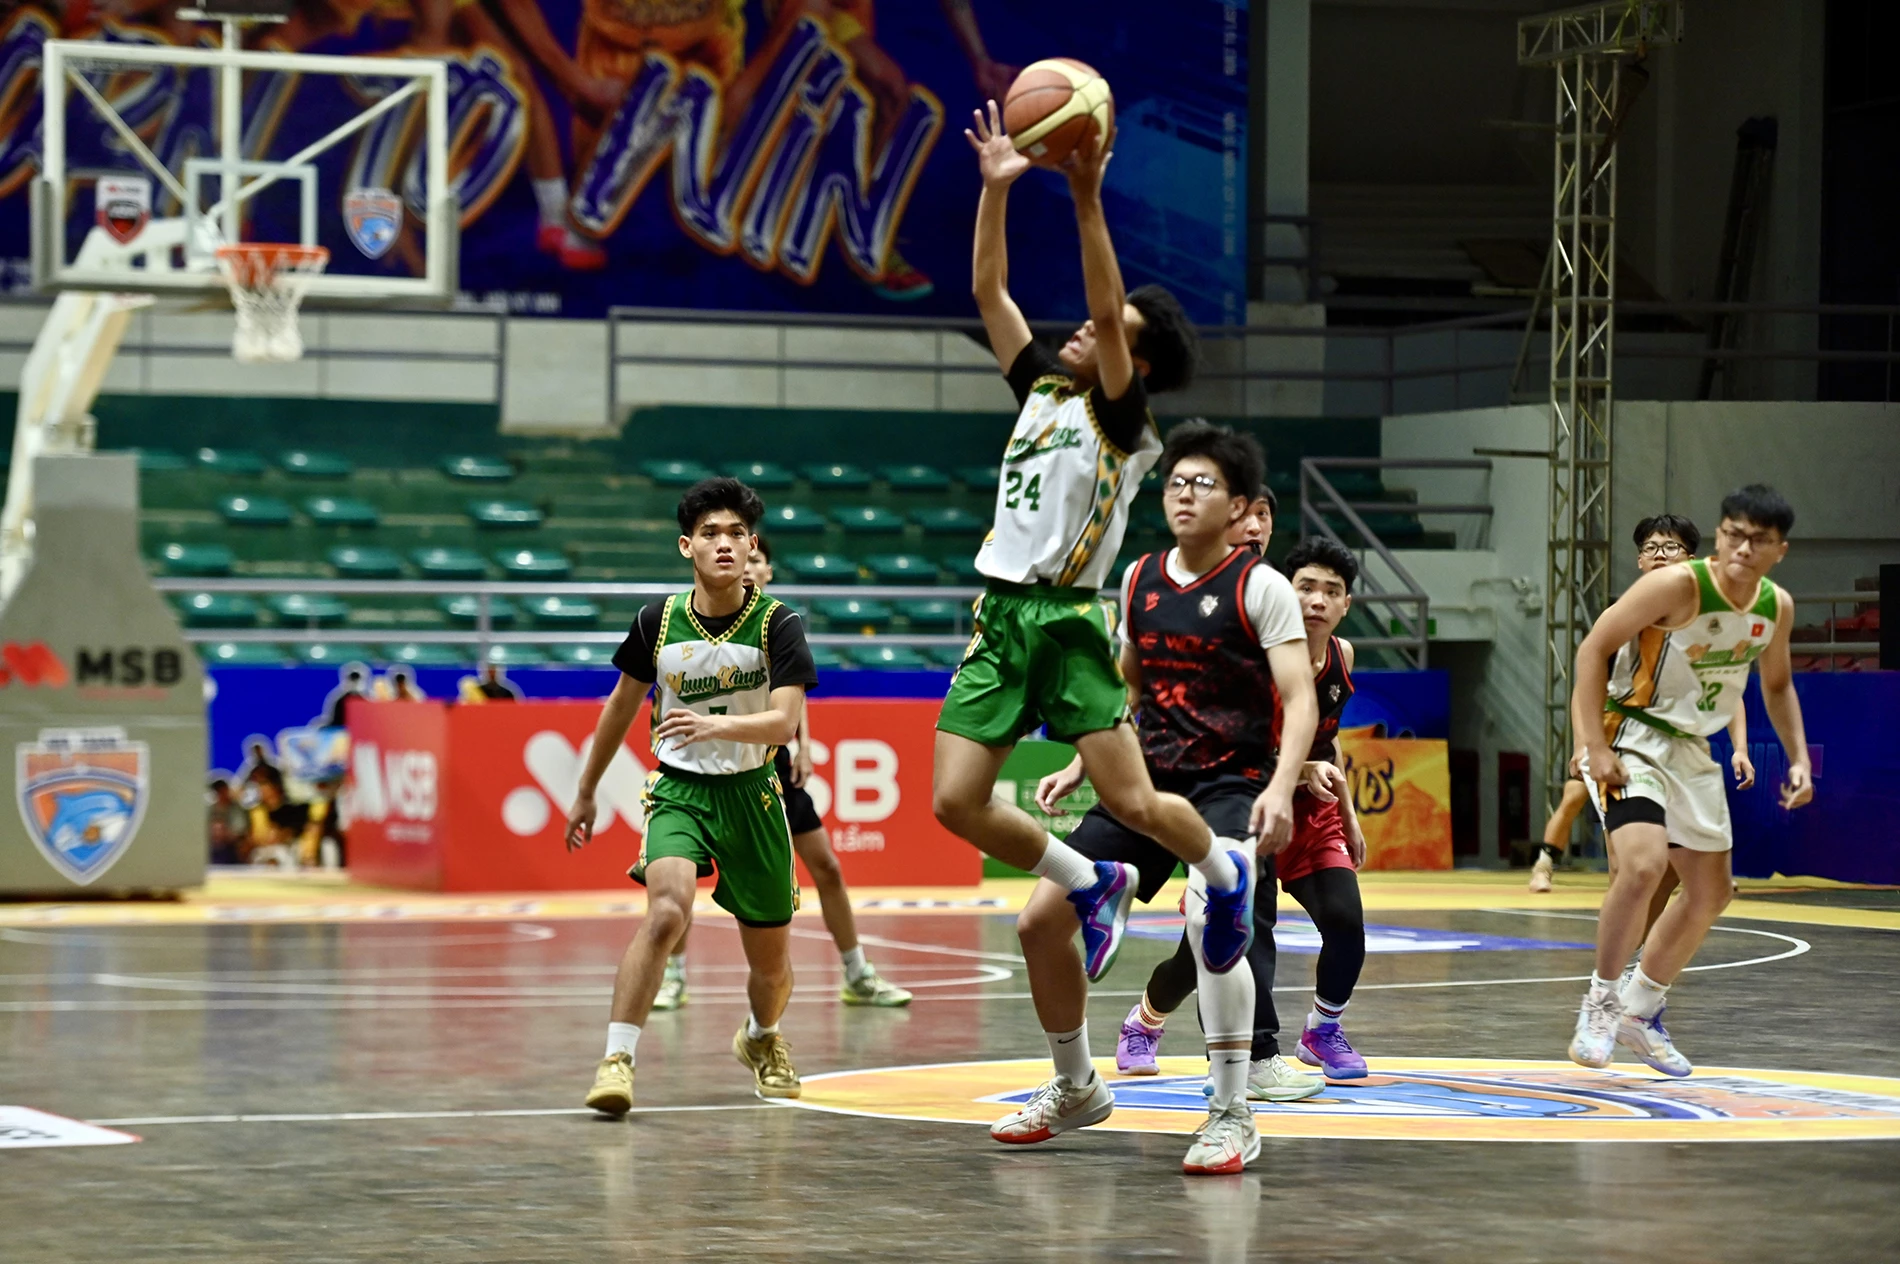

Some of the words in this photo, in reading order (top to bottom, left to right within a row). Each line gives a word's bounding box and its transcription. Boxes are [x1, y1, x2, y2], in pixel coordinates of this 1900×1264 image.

[1005, 470, 1042, 512] 24
[76, 646, 183, 688] MSB
[786, 738, 901, 823] SB
